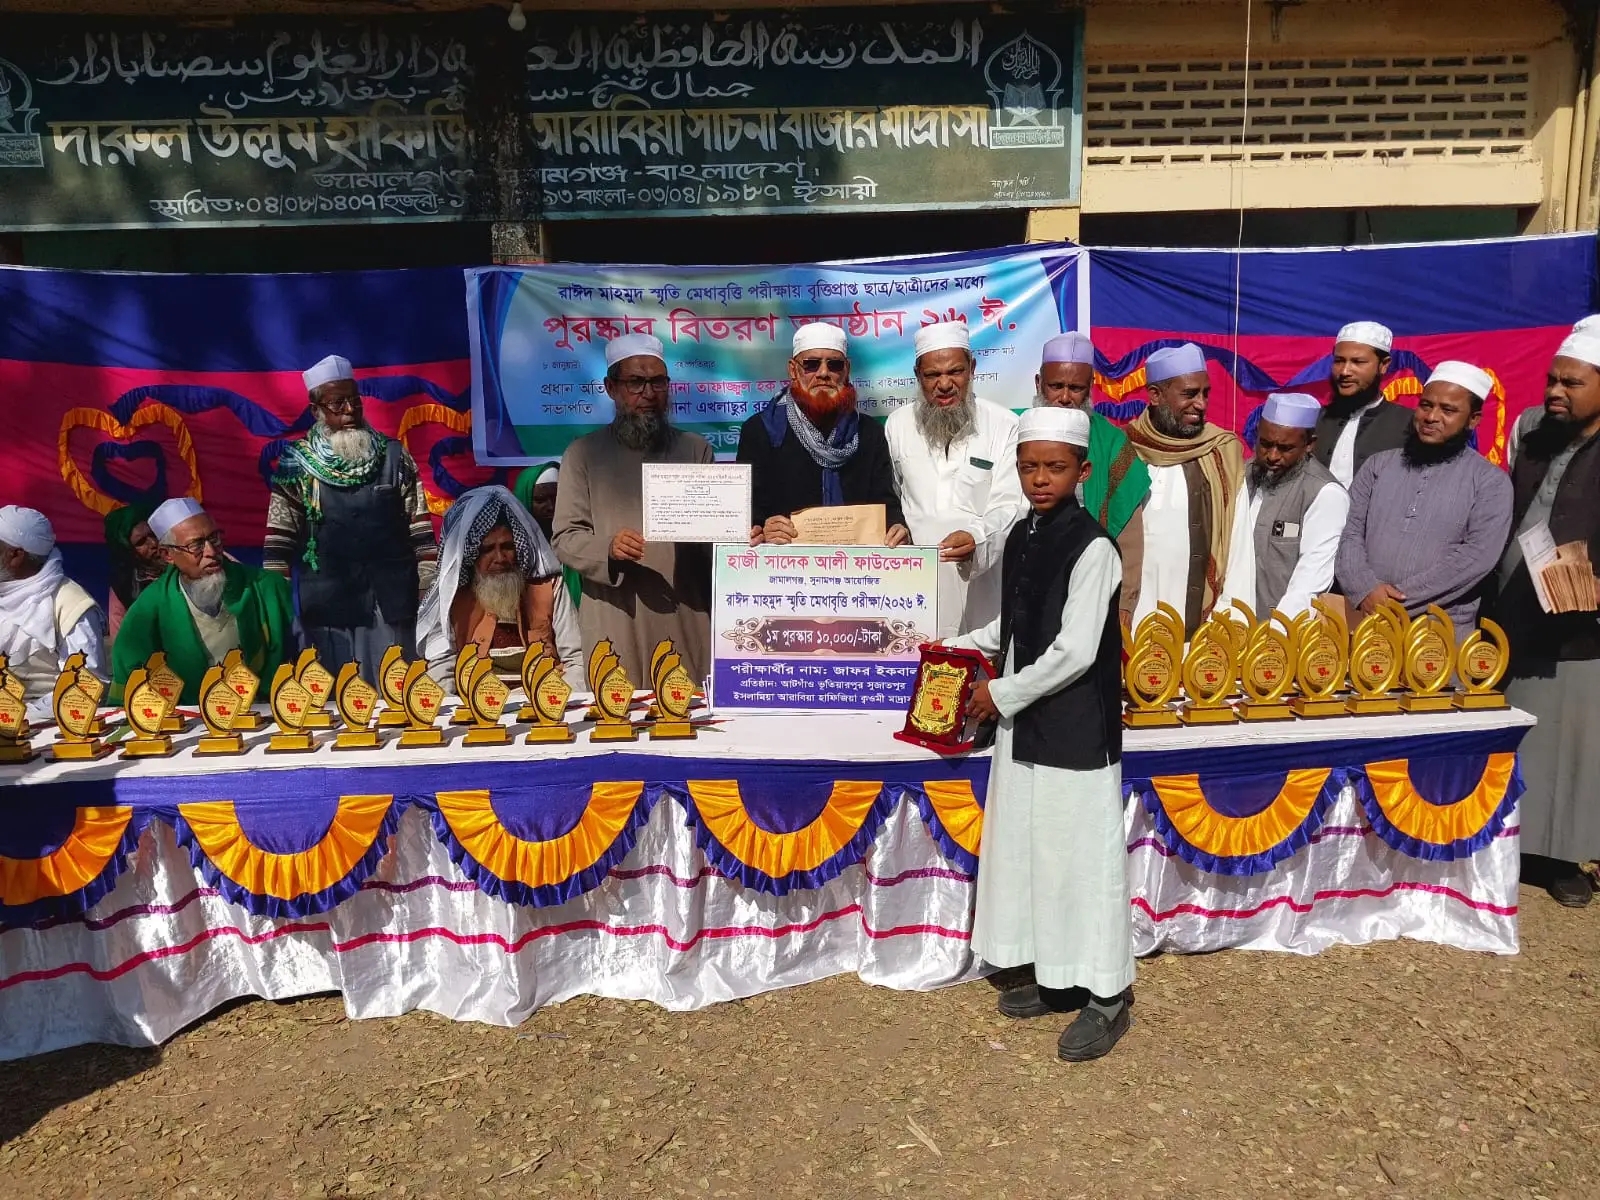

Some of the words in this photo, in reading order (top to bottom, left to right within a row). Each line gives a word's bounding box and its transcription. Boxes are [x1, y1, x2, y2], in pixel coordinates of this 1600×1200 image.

[46, 117, 193, 167] দারুল
[528, 93, 684, 156] আরাবিয়া
[684, 107, 779, 153] সাচনা
[779, 106, 880, 154] বাজার
[879, 104, 990, 150] মাদ্রাসা
[645, 155, 807, 183] বাংলাদেশ
[557, 283, 594, 300] রাঈদ
[597, 286, 644, 305] মাহমুদ
[650, 283, 681, 307] স্মৃতি
[686, 282, 744, 306] মেধাবৃত্তি
[748, 280, 802, 299] পরীক্ষায়
[807, 279, 859, 302] বৃত্তিপ্রাপ্ত
[862, 277, 950, 298] ছাত্র/ছাত্রীদের
[954, 275, 987, 290] মধ্যে
[666, 307, 780, 344] বিতরণ
[540, 382, 575, 396] প্রধান
[755, 380, 777, 393] হক
[541, 399, 593, 416] সভাপতি
[727, 549, 760, 571] হাজী
[765, 554, 809, 572] সাদেক
[814, 550, 848, 571] আলী
[854, 552, 924, 572] ফাউন্ডেশন
[810, 576, 841, 587] সুনামগঞ্জ
[843, 574, 881, 586] আয়োজিত
[726, 591, 750, 608] রাঈদ
[752, 593, 783, 611] মাহমুদ
[785, 591, 807, 612] স্মৃতি
[810, 591, 849, 614] মেধাবৃত্তি
[766, 630, 779, 645] ১ম
[730, 662, 794, 677] পরীক্ষার্থীর
[832, 665, 870, 676] জাফর
[866, 680, 907, 691] সুজাতপুর
[733, 691, 774, 703] ইসলামিয়া
[777, 692, 816, 704] আরাবিয়া
[818, 692, 857, 703] হাফিজিয়া
